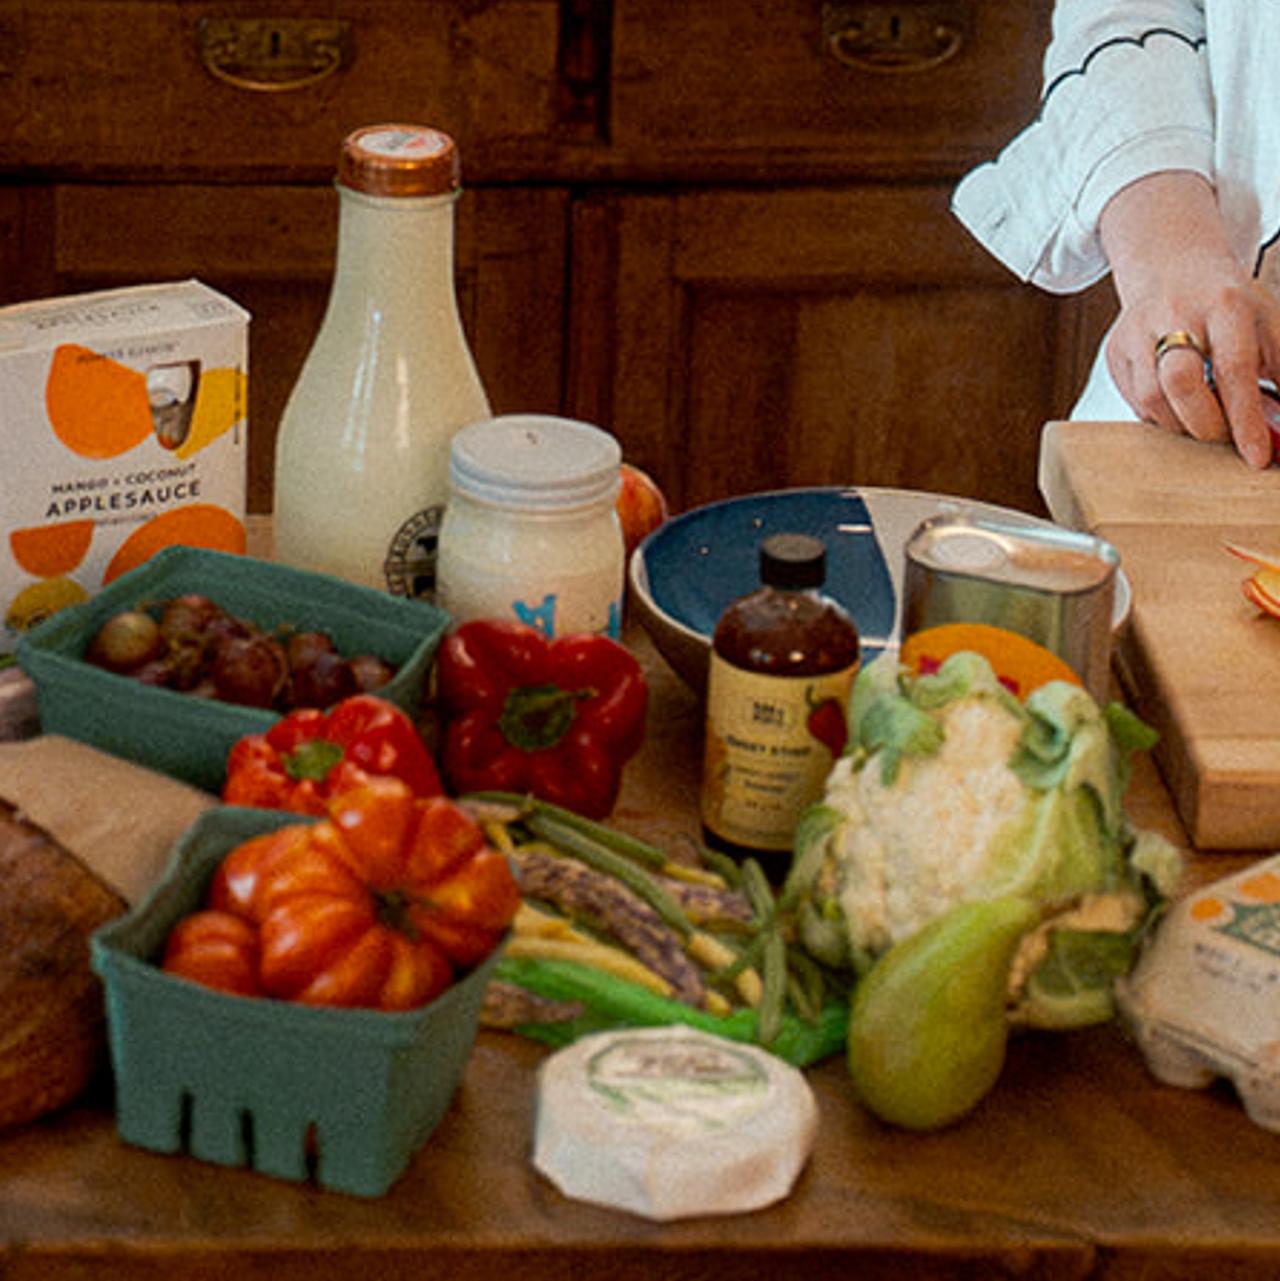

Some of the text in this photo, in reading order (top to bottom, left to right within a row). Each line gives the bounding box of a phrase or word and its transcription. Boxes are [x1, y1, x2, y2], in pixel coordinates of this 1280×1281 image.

[51, 476, 109, 494] MANGO
[124, 462, 196, 486] COCONUT
[45, 479, 201, 518] APPLESAUCE
